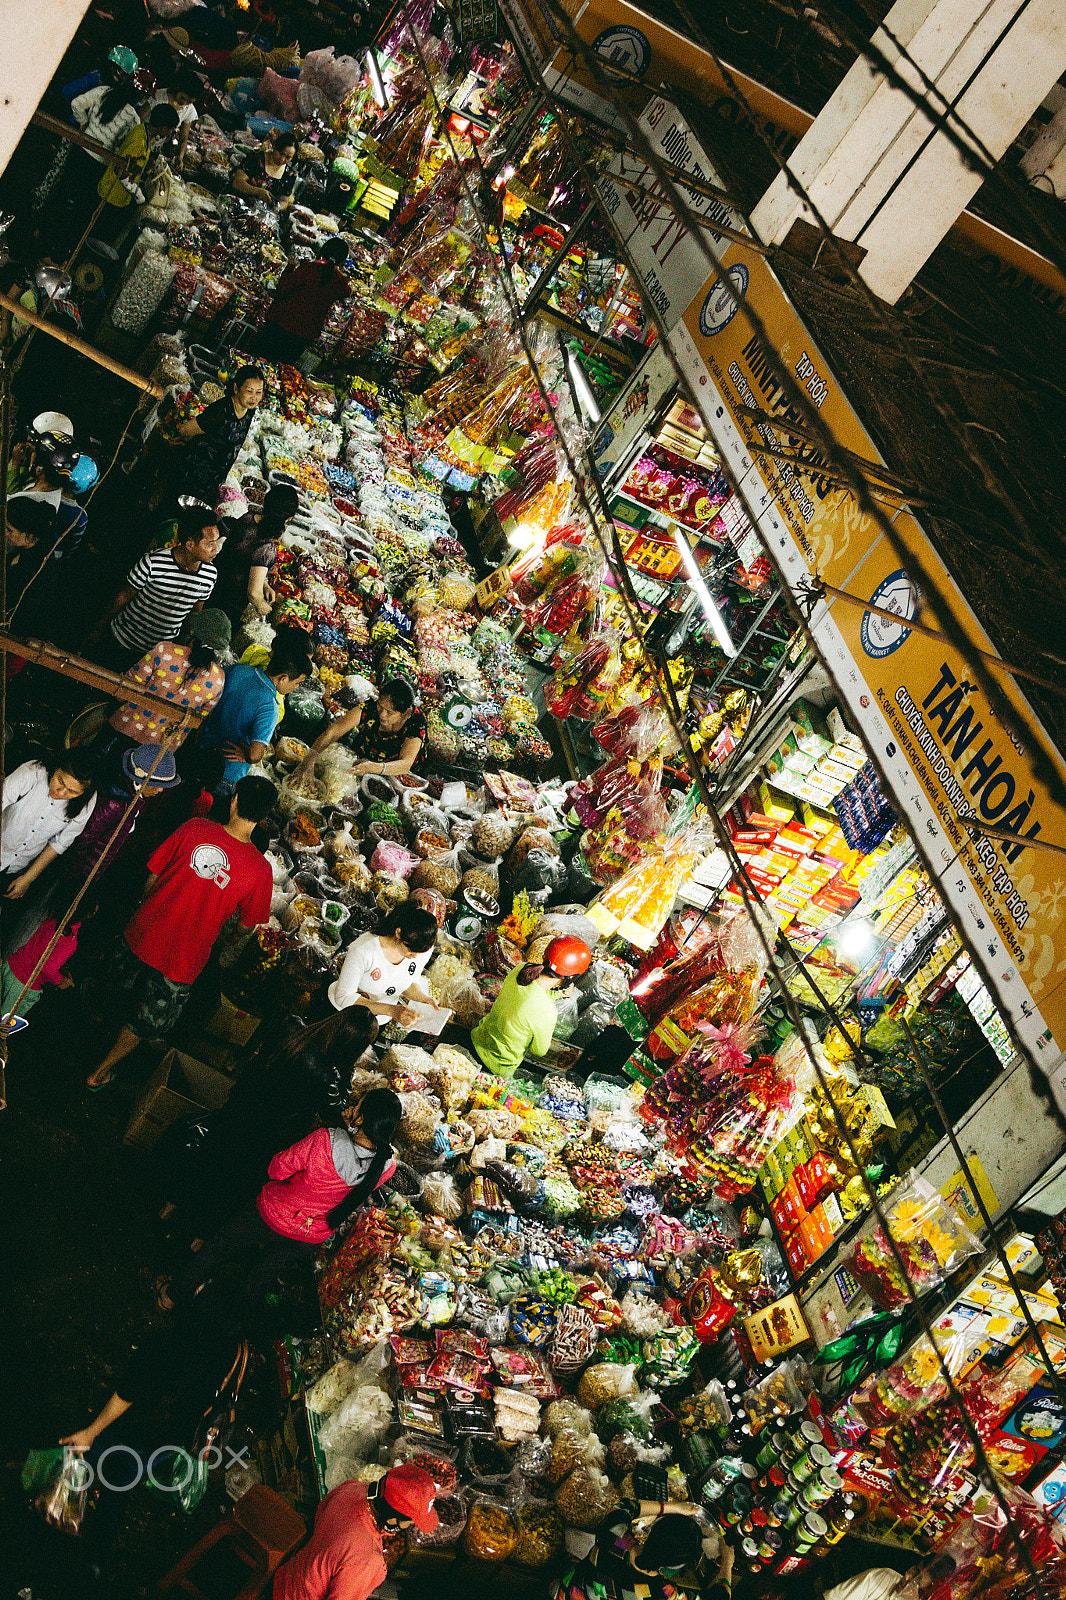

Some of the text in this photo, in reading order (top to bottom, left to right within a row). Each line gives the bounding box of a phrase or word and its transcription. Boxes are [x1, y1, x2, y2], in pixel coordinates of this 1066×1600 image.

[646, 102, 667, 131] 131
[727, 360, 750, 397] CHUYÊN
[786, 476, 804, 503] TẠP
[795, 493, 813, 524] HÓA
[794, 351, 828, 408] TẠP HÓA
[891, 717, 902, 731] 133
[897, 728, 909, 745] KHU
[908, 748, 922, 766] CHỢ
[916, 763, 927, 780] LIÊN
[923, 776, 940, 801] NGHĨA
[973, 872, 985, 889] 384
[981, 886, 994, 907] 1213
[992, 908, 1006, 930] 0164
[1003, 928, 1016, 949] 2454
[1013, 946, 1025, 963] 879
[894, 685, 925, 737] CHUYÊN
[917, 729, 942, 769] KINH
[934, 760, 965, 813] DOANH
[992, 866, 1011, 899] TẠP
[1005, 892, 1027, 930] HÓA
[922, 663, 1042, 863] TẤN HOÀI
[955, 879, 966, 893] PS
